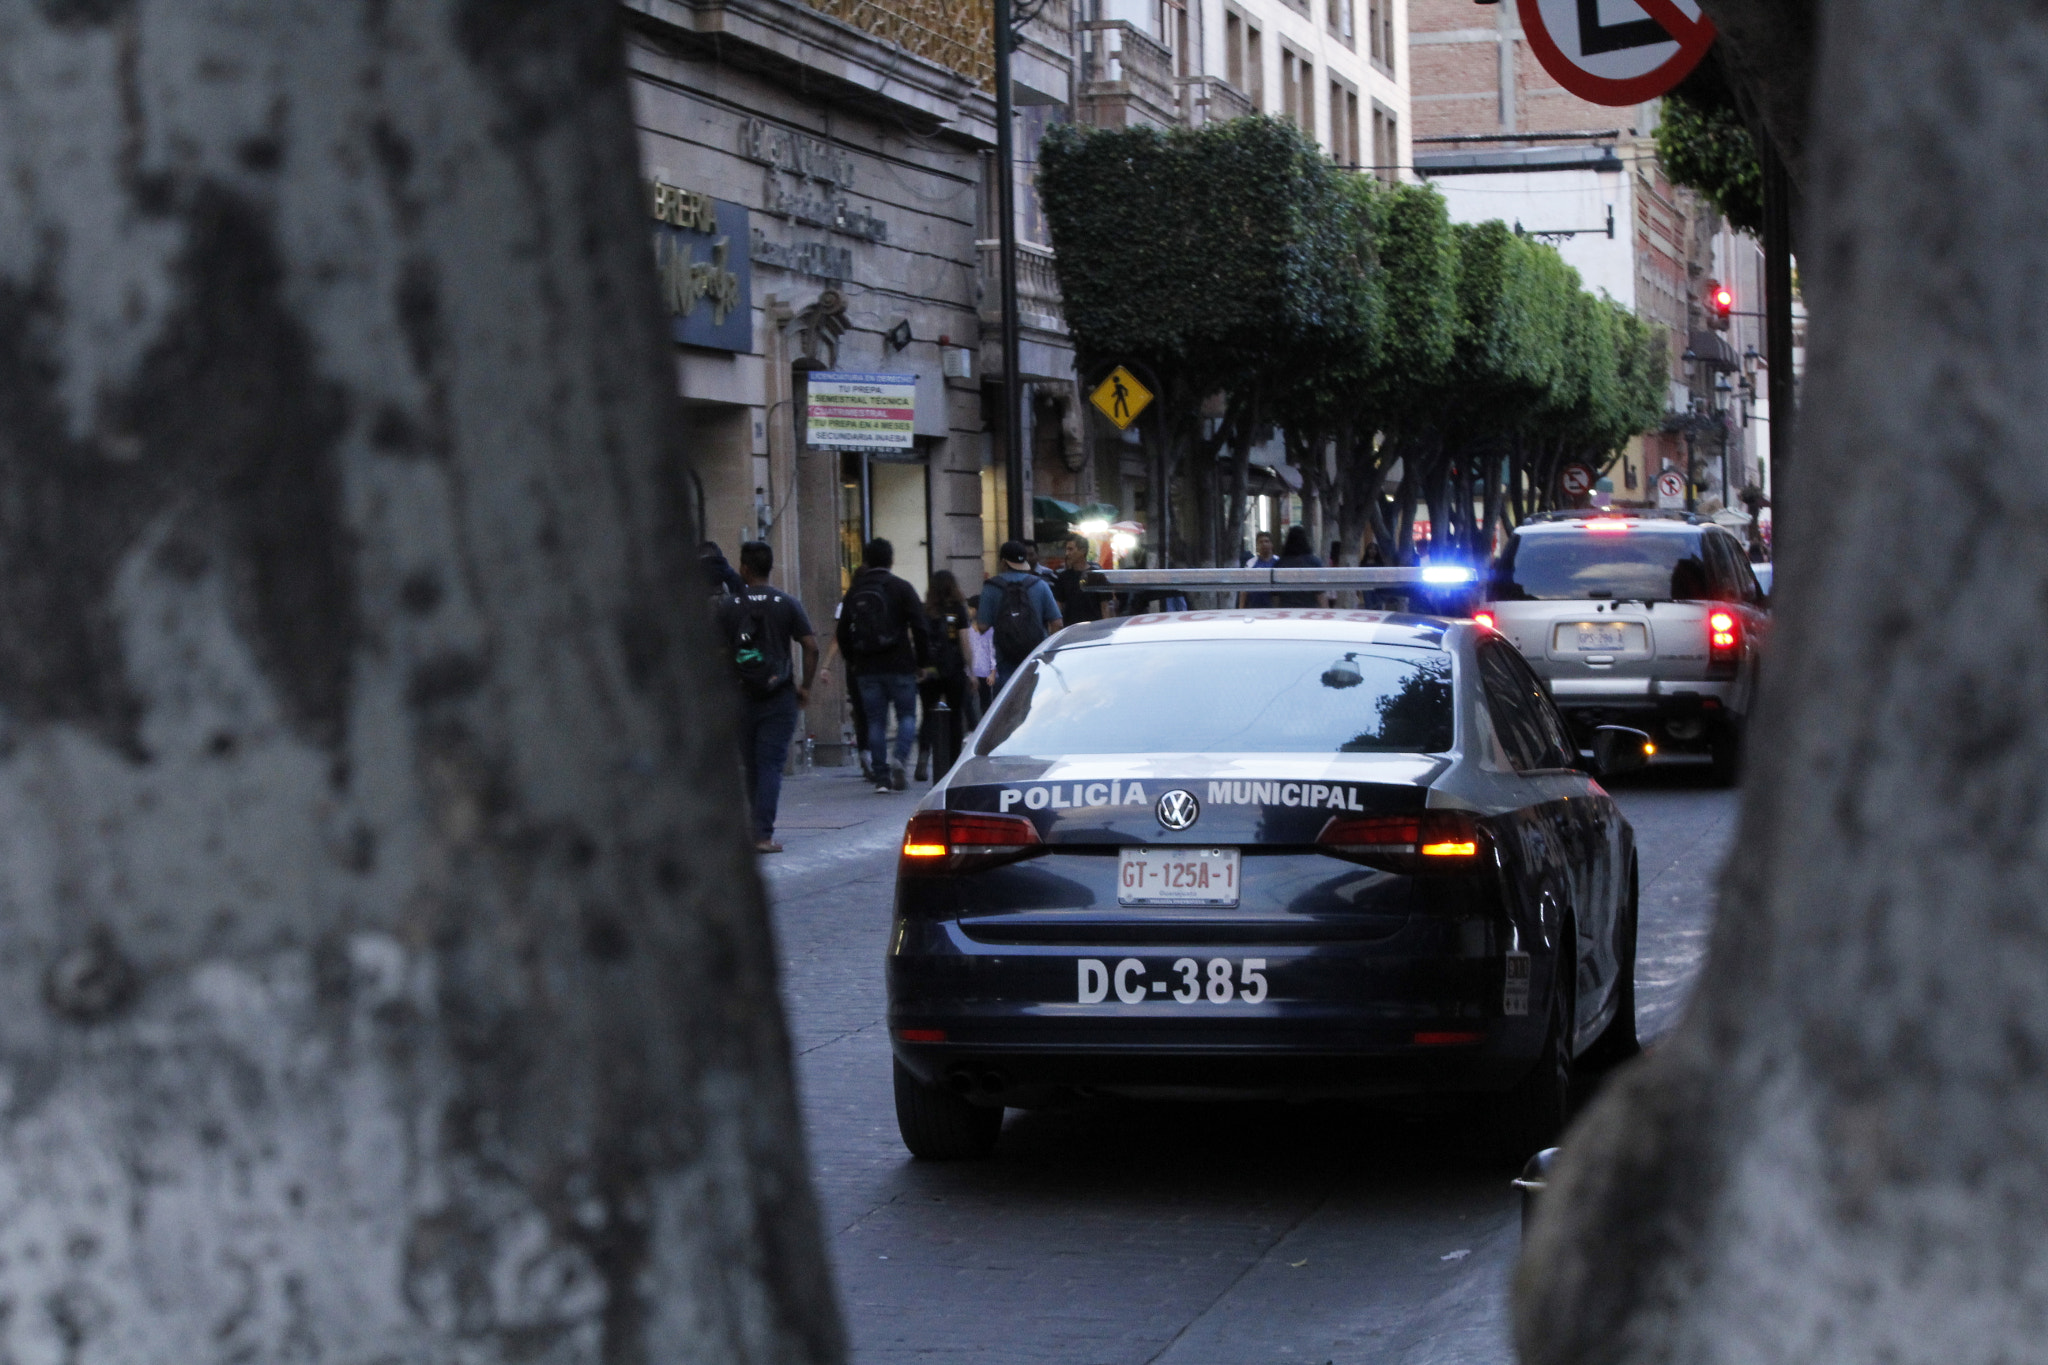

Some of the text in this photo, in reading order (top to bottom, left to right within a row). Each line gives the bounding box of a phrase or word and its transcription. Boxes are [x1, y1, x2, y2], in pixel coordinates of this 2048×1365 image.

[839, 385, 850, 393] TU
[815, 394, 867, 404] SEMESTRAL
[815, 419, 826, 427] TU
[828, 419, 857, 428] PREPA
[881, 422, 910, 430] MESES
[815, 431, 873, 441] SECUNDARIA
[1000, 778, 1364, 812] POLICÍA MUNICIPAL
[1123, 861, 1233, 888] GT-125A-1
[1078, 957, 1268, 1004] DC-385
